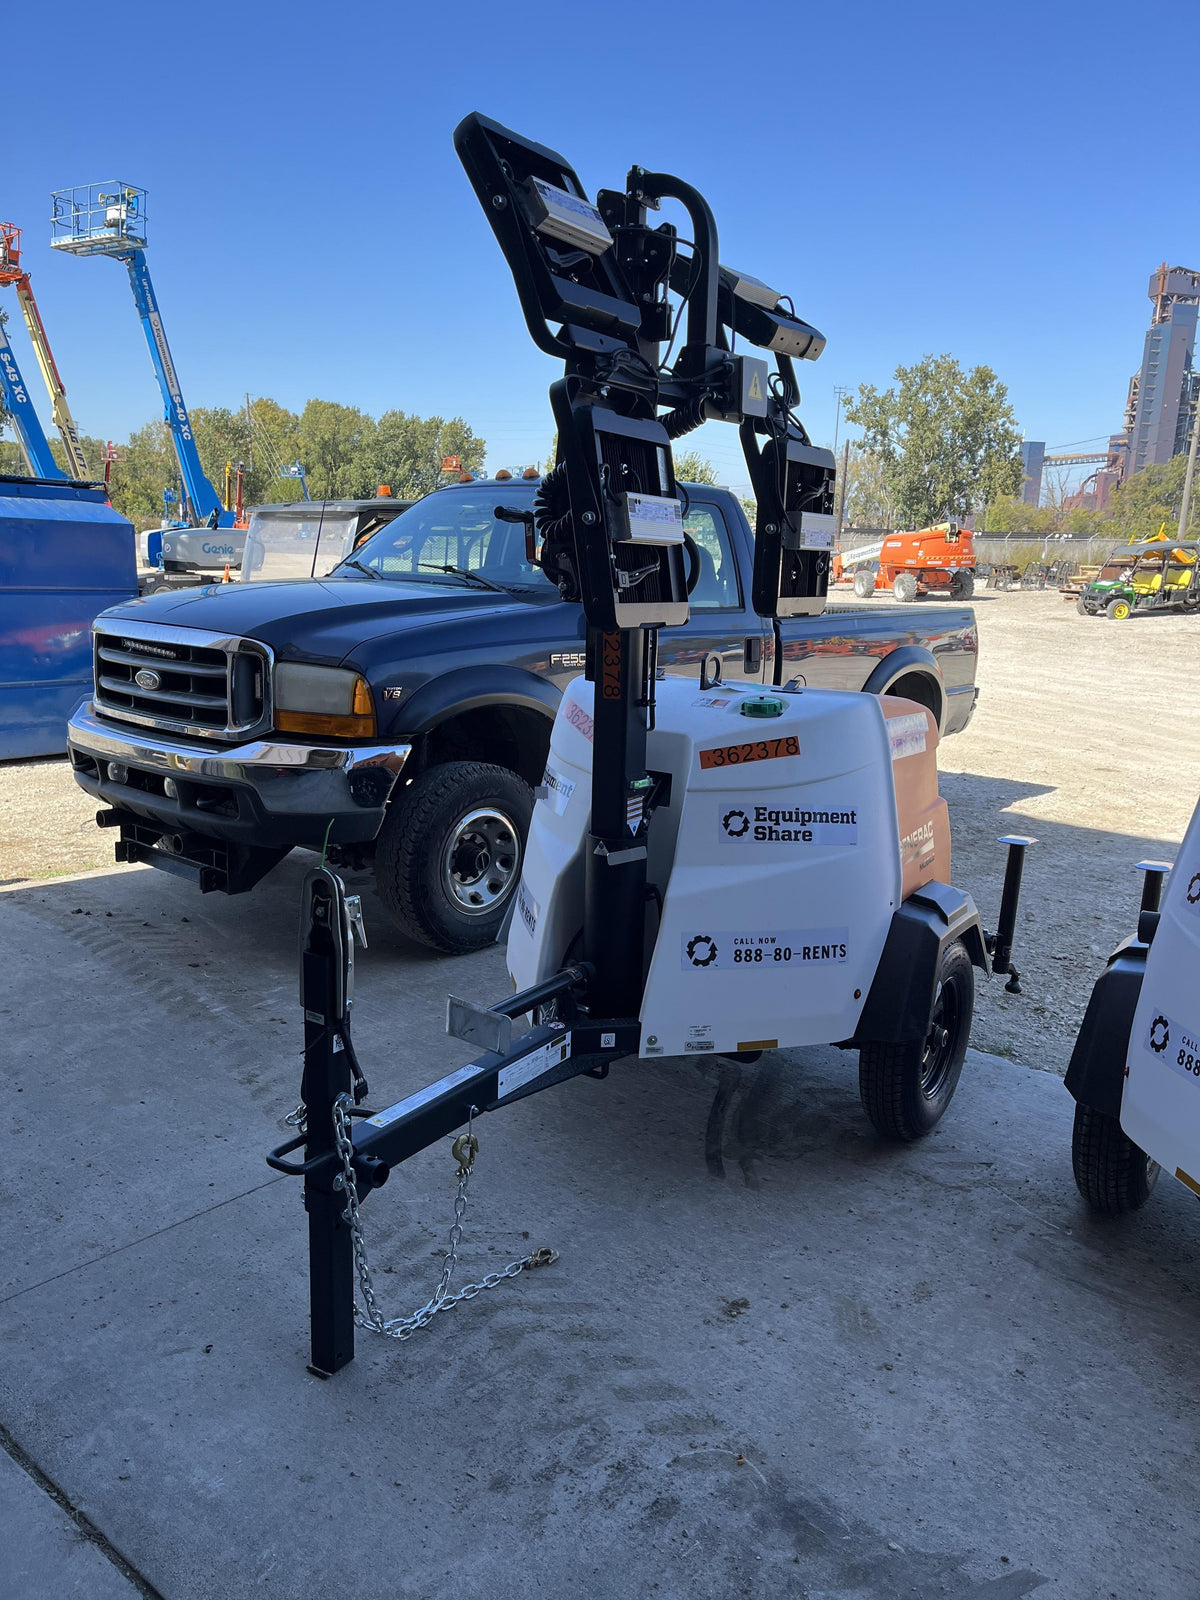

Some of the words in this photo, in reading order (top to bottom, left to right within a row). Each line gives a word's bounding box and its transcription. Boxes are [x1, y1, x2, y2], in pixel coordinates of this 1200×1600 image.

[155, 327, 175, 389] EquipmentShare
[1, 352, 19, 382] S-45
[12, 384, 27, 403] XC
[173, 395, 187, 421] S-40
[180, 423, 192, 440] XC
[66, 424, 79, 444] JLG
[74, 446, 87, 469] LIFT
[202, 543, 234, 554] Genie
[383, 690, 401, 701] V8
[713, 737, 799, 766] 362378
[754, 806, 857, 826] Equipment
[754, 826, 813, 842] Share
[733, 944, 847, 963] 888-80-RENTS
[1181, 1036, 1198, 1052] CALL
[1177, 1049, 1200, 1077] 888
